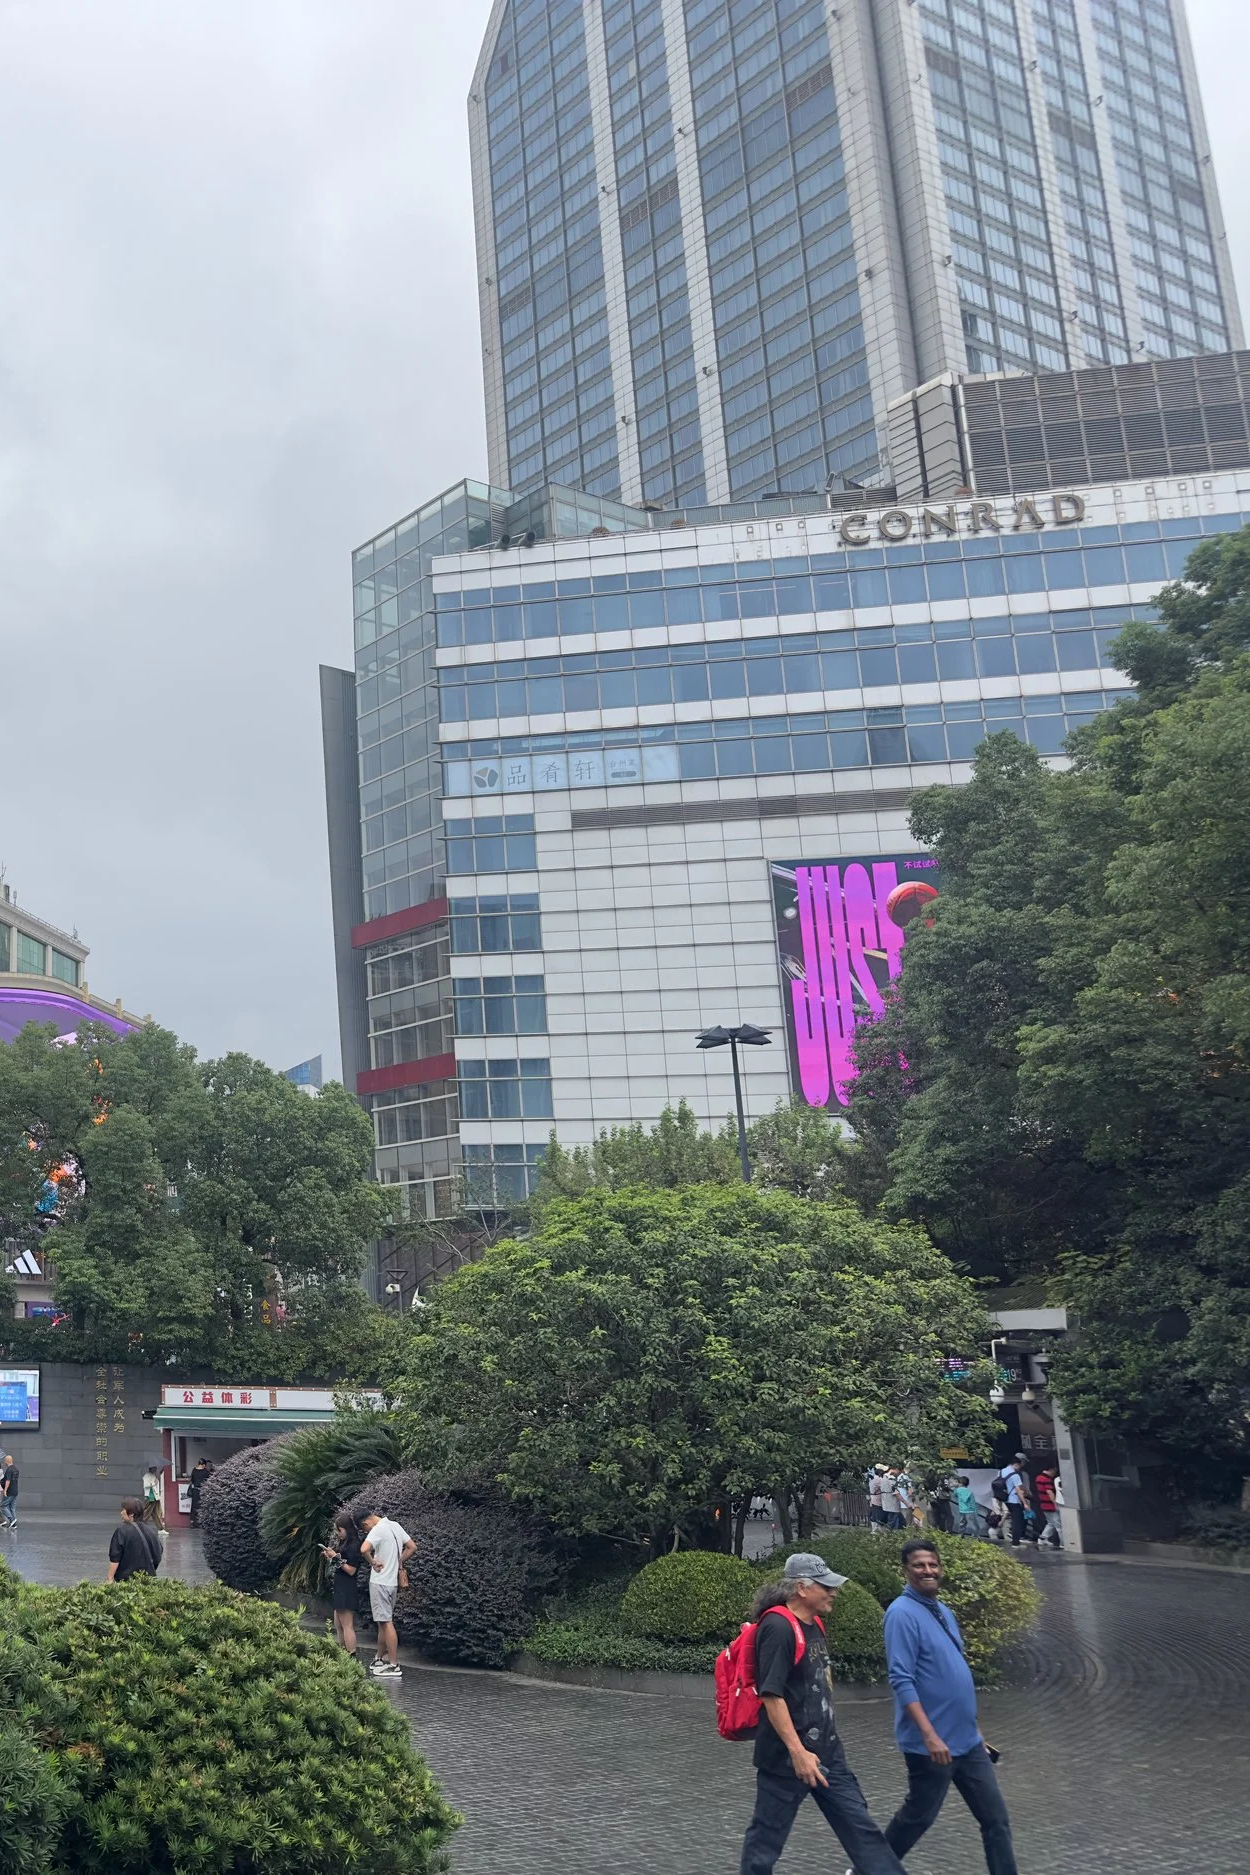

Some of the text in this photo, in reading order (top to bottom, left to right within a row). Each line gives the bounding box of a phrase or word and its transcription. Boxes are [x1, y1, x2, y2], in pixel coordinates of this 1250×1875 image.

[841, 493, 1086, 545] CONRAD
[507, 759, 596, 787] 品肴轩
[96, 1366, 107, 1476] 全社会尊崇的职业
[113, 1366, 125, 1433] 让军人成为
[182, 1390, 253, 1405] 公益体彩
